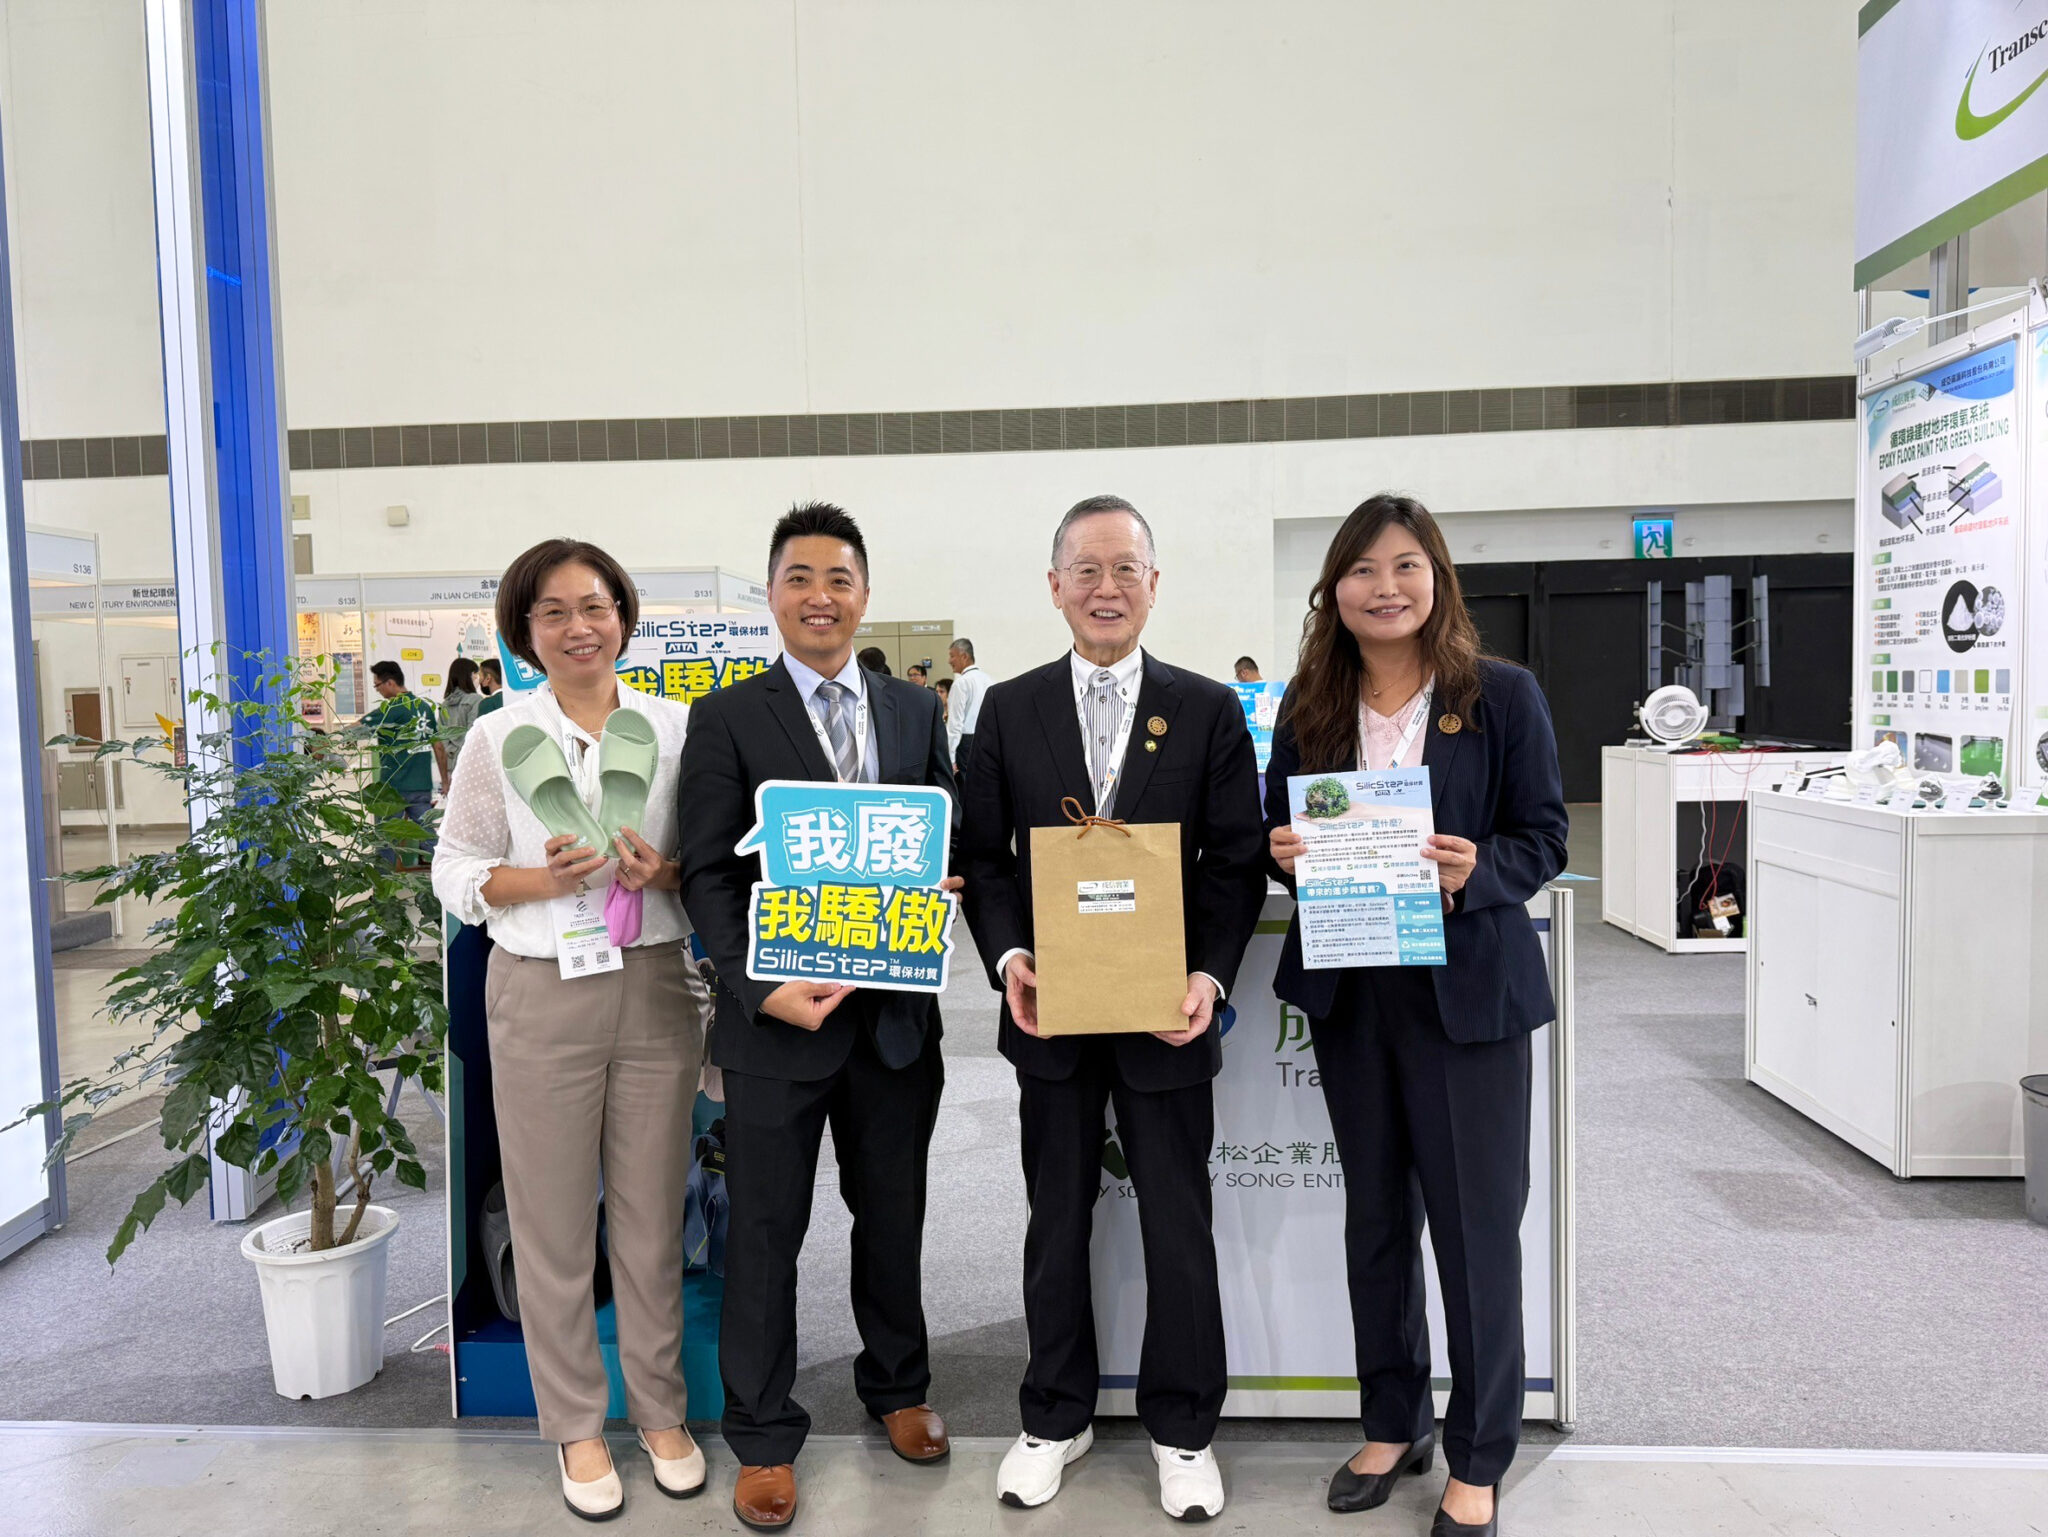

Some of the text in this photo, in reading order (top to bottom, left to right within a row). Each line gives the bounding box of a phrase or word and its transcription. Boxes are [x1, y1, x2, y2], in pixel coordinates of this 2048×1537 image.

[1879, 417, 2009, 470] EPOXY FLOOR PAINT FOR GREEN BUILDING
[73, 563, 92, 575] S136
[132, 587, 175, 598] 新世紀環保
[430, 590, 491, 600] JIN LIAN CHENG
[694, 590, 712, 598] S131
[69, 601, 88, 609] NEW
[337, 597, 357, 605] S135
[785, 802, 928, 874] 我廢
[758, 883, 948, 955] 我驕傲
[888, 965, 938, 981] 環保材質
[1275, 1061, 1323, 1088] Tra
[1207, 1141, 1341, 1165] 松企業
[1225, 1172, 1295, 1188] SONG
[1303, 1173, 1343, 1188] ENT
